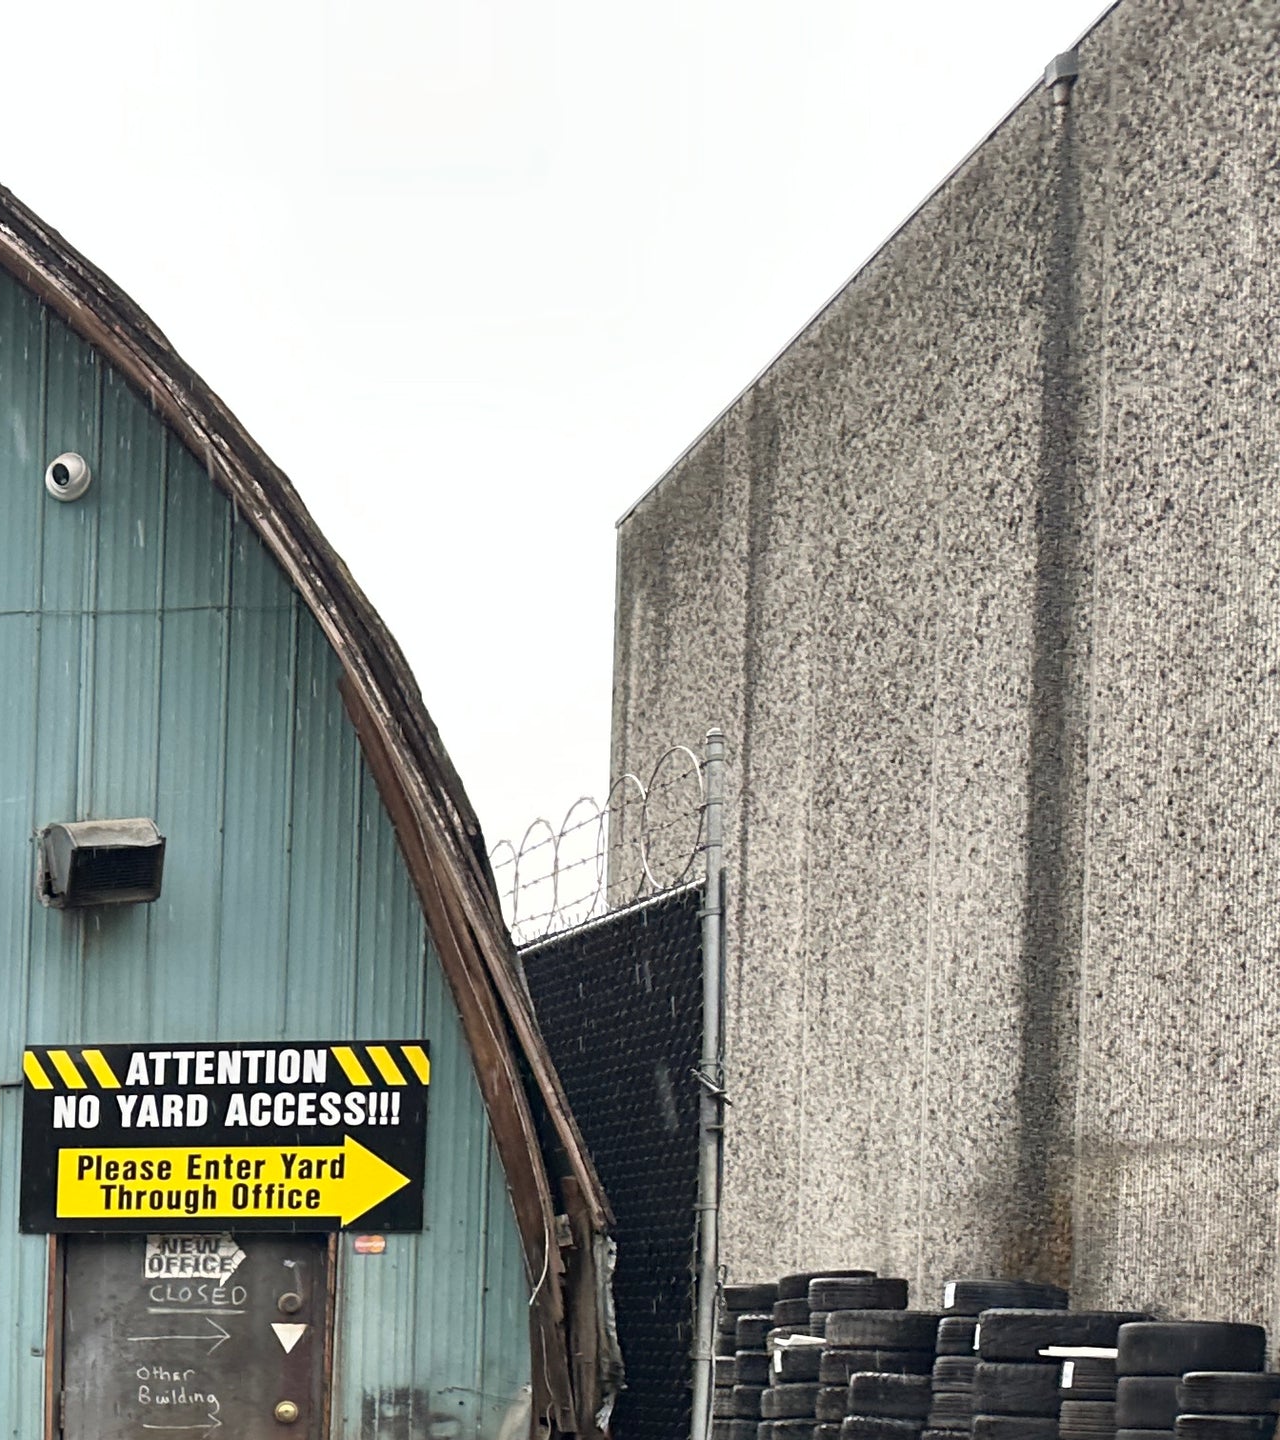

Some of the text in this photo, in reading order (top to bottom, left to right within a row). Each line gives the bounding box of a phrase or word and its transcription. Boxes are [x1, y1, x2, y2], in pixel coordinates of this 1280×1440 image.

[125, 1049, 327, 1086] ATTENTION
[53, 1092, 401, 1128] NO YARD ACCESS!!!
[77, 1152, 346, 1181] Please Enter Yard
[100, 1183, 321, 1214] Through Office
[160, 1238, 223, 1254] NEW
[148, 1254, 236, 1274] OFFICE
[149, 1284, 247, 1306] CLOSED
[138, 1385, 221, 1415] Building
